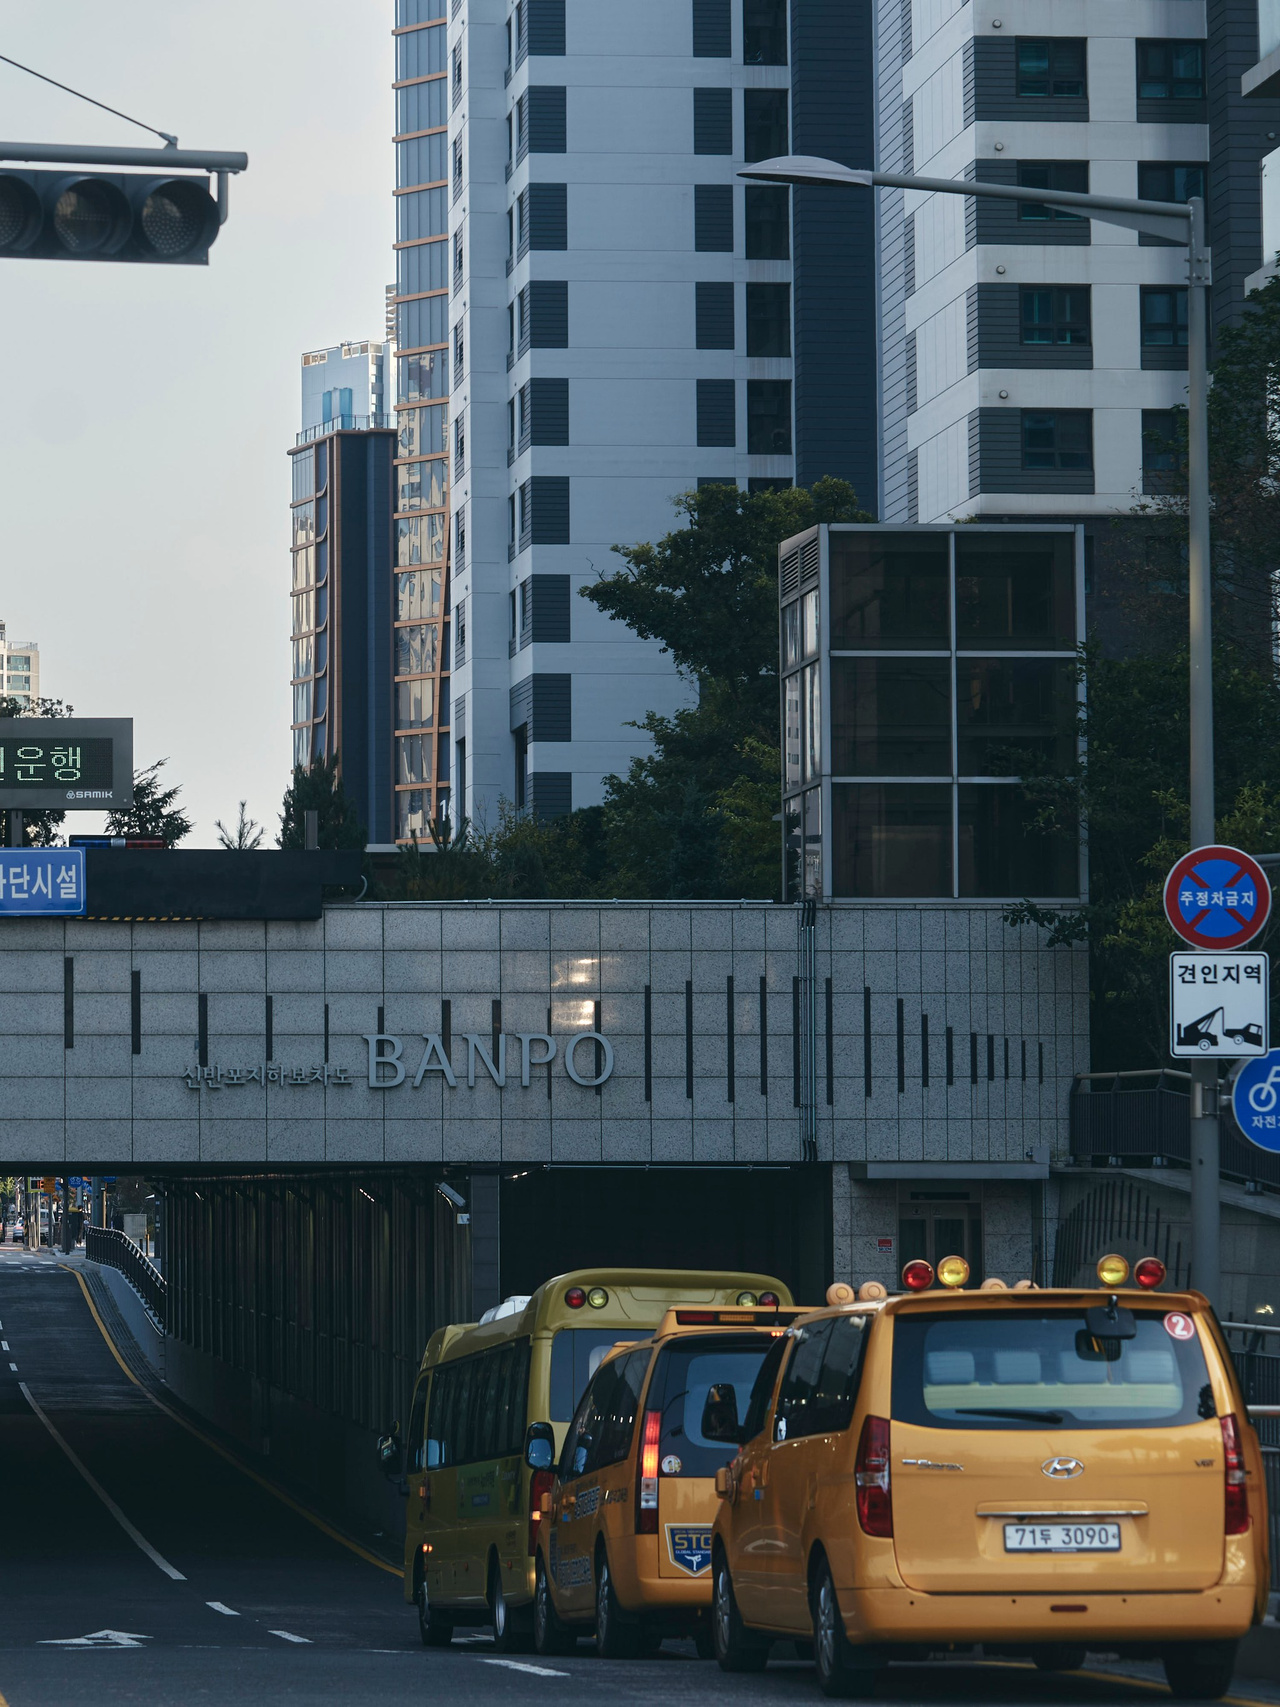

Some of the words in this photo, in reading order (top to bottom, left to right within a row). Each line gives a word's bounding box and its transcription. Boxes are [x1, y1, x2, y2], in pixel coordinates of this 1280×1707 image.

[1180, 891, 1254, 906] 주정차금지
[1178, 964, 1261, 984] 견인지역
[362, 1032, 614, 1088] BANPO
[182, 1064, 353, 1088] 신반포지하보차도
[1171, 1315, 1188, 1335] 2
[1015, 1527, 1052, 1545] 71두
[1061, 1527, 1109, 1545] 3090
